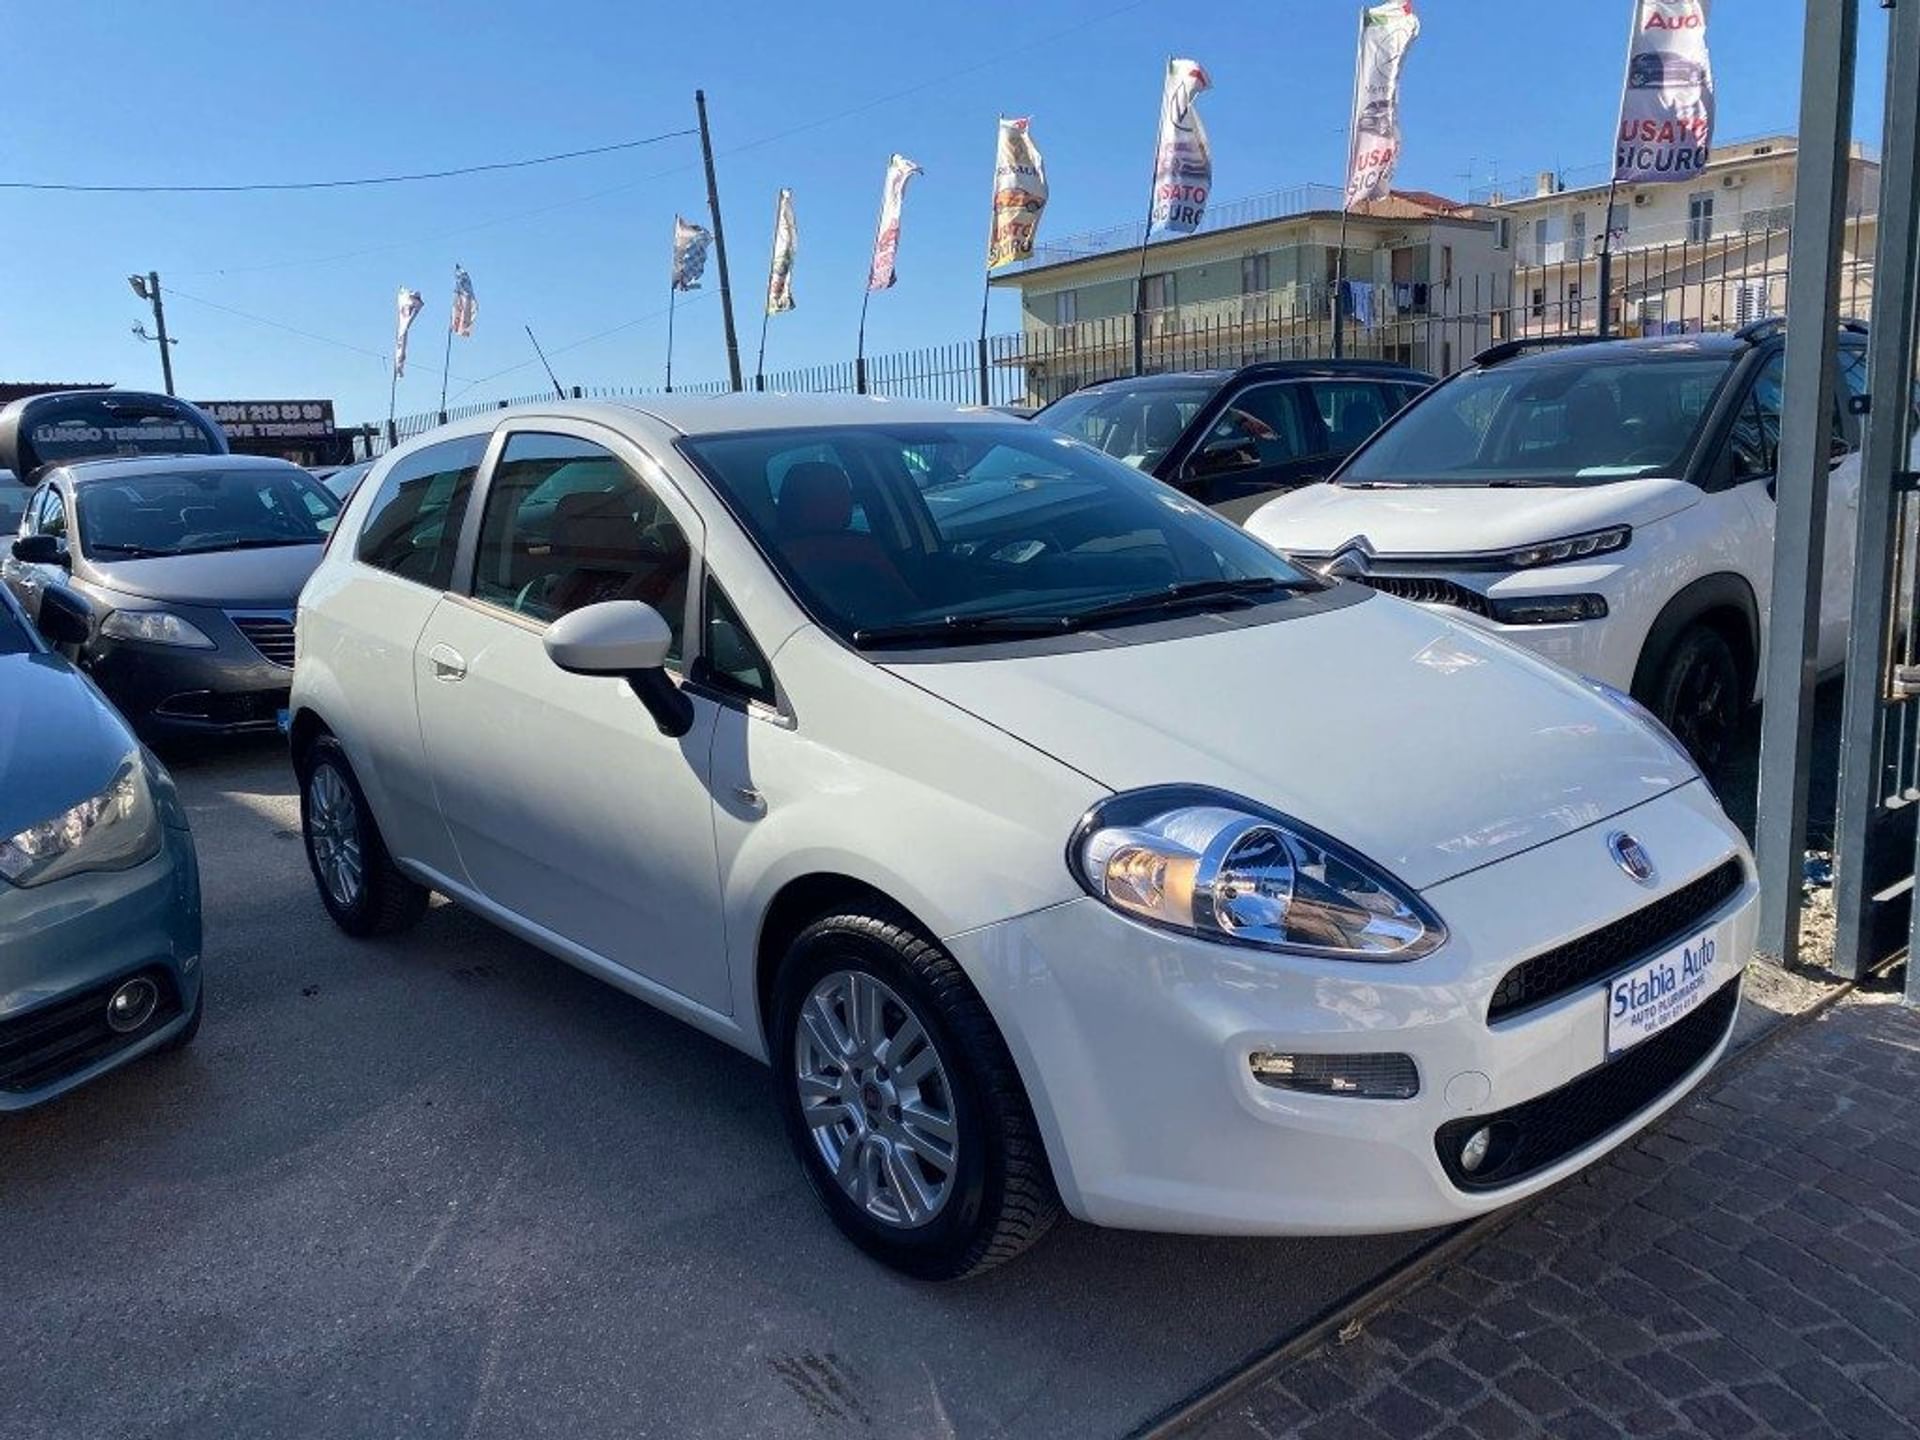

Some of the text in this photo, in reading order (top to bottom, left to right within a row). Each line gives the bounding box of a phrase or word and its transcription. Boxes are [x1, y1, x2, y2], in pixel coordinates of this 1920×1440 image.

[1161, 184, 1205, 204] SATO
[1614, 937, 1715, 1018] Stabia Auto
[1631, 1004, 1657, 1027] AUTO
